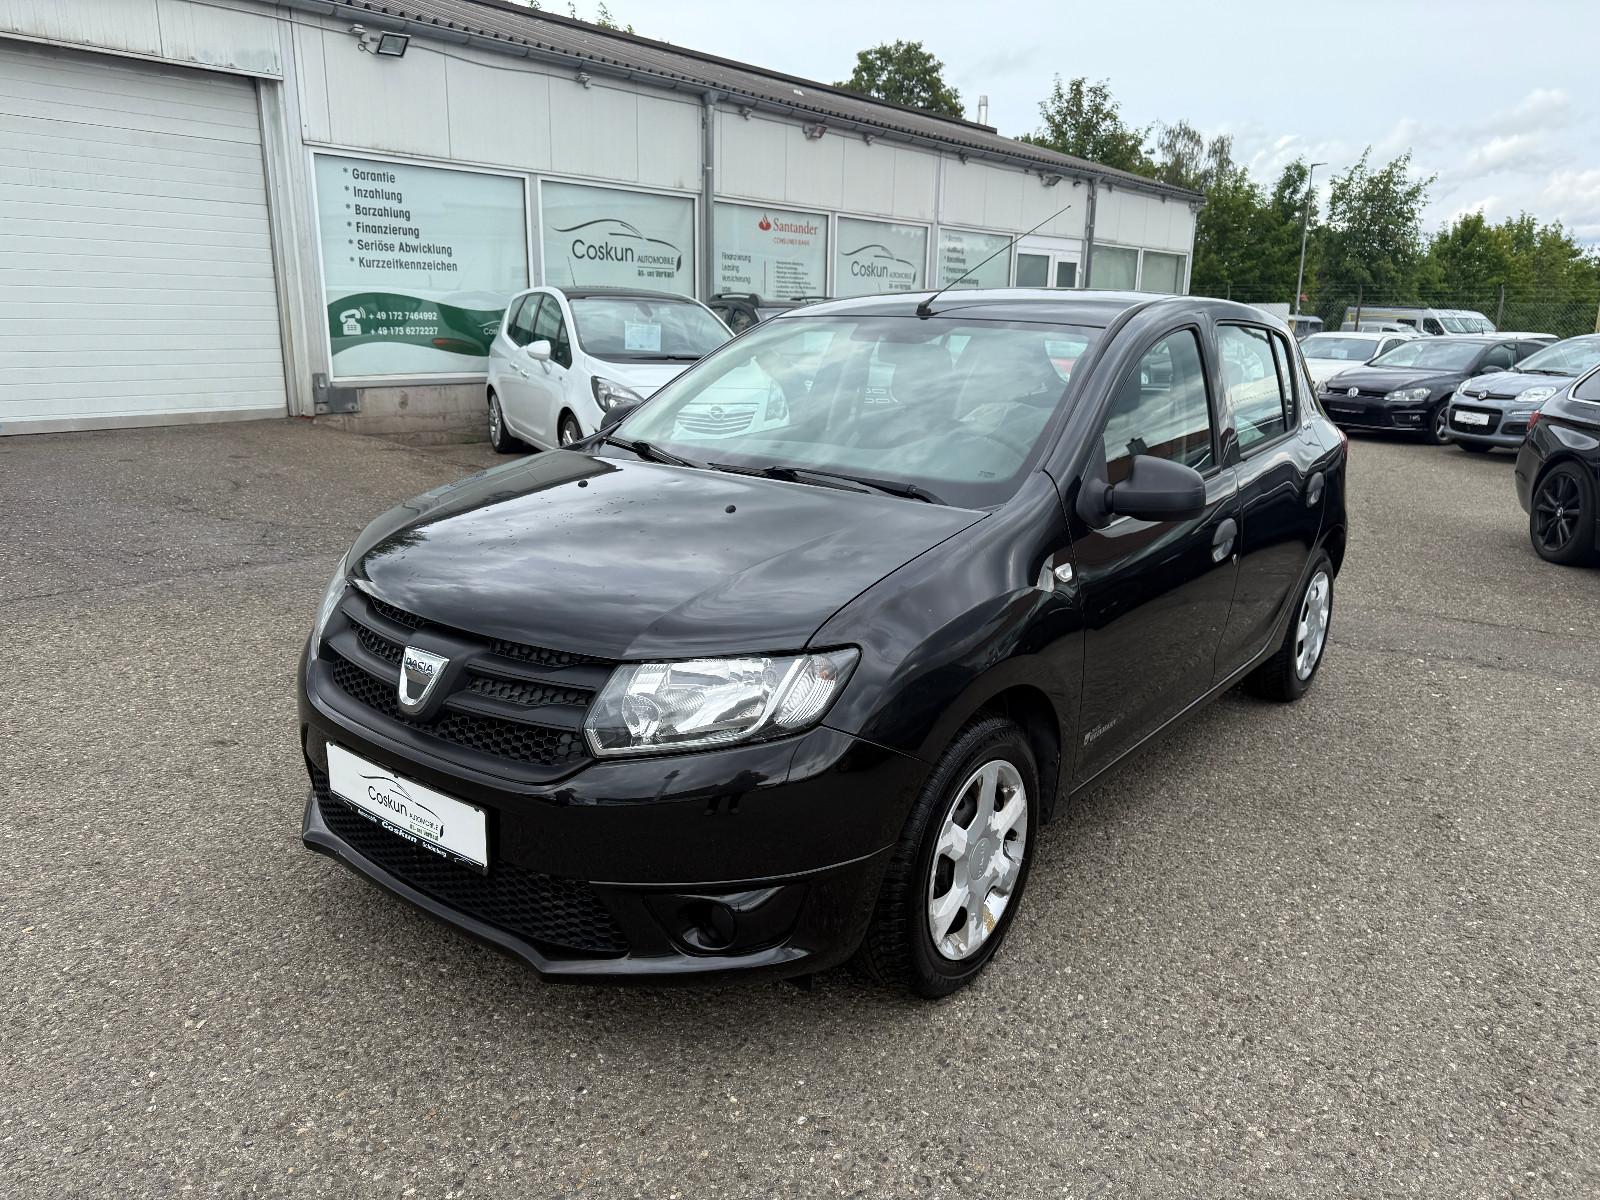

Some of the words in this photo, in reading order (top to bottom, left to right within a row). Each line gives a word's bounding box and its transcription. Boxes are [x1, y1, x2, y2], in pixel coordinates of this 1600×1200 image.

[352, 167, 396, 184] Garantie
[353, 186, 403, 204] Inzahlung
[354, 204, 411, 222] Barzahlung
[356, 221, 420, 239] Finanzierung
[773, 217, 818, 235] Santander
[357, 239, 395, 252] Seriöse
[399, 239, 453, 258] Abwicklung
[571, 239, 634, 263] Coskun
[637, 255, 675, 266] AUTOMOBILE
[358, 256, 458, 272] Kurzzeitkennzeichen
[850, 260, 889, 278] Coskun
[376, 311, 387, 320] 49
[388, 311, 403, 320] 172
[404, 311, 438, 321] 7464992
[405, 656, 434, 674] DACIA
[367, 785, 408, 817] Coskun
[381, 820, 418, 843] Coskun
